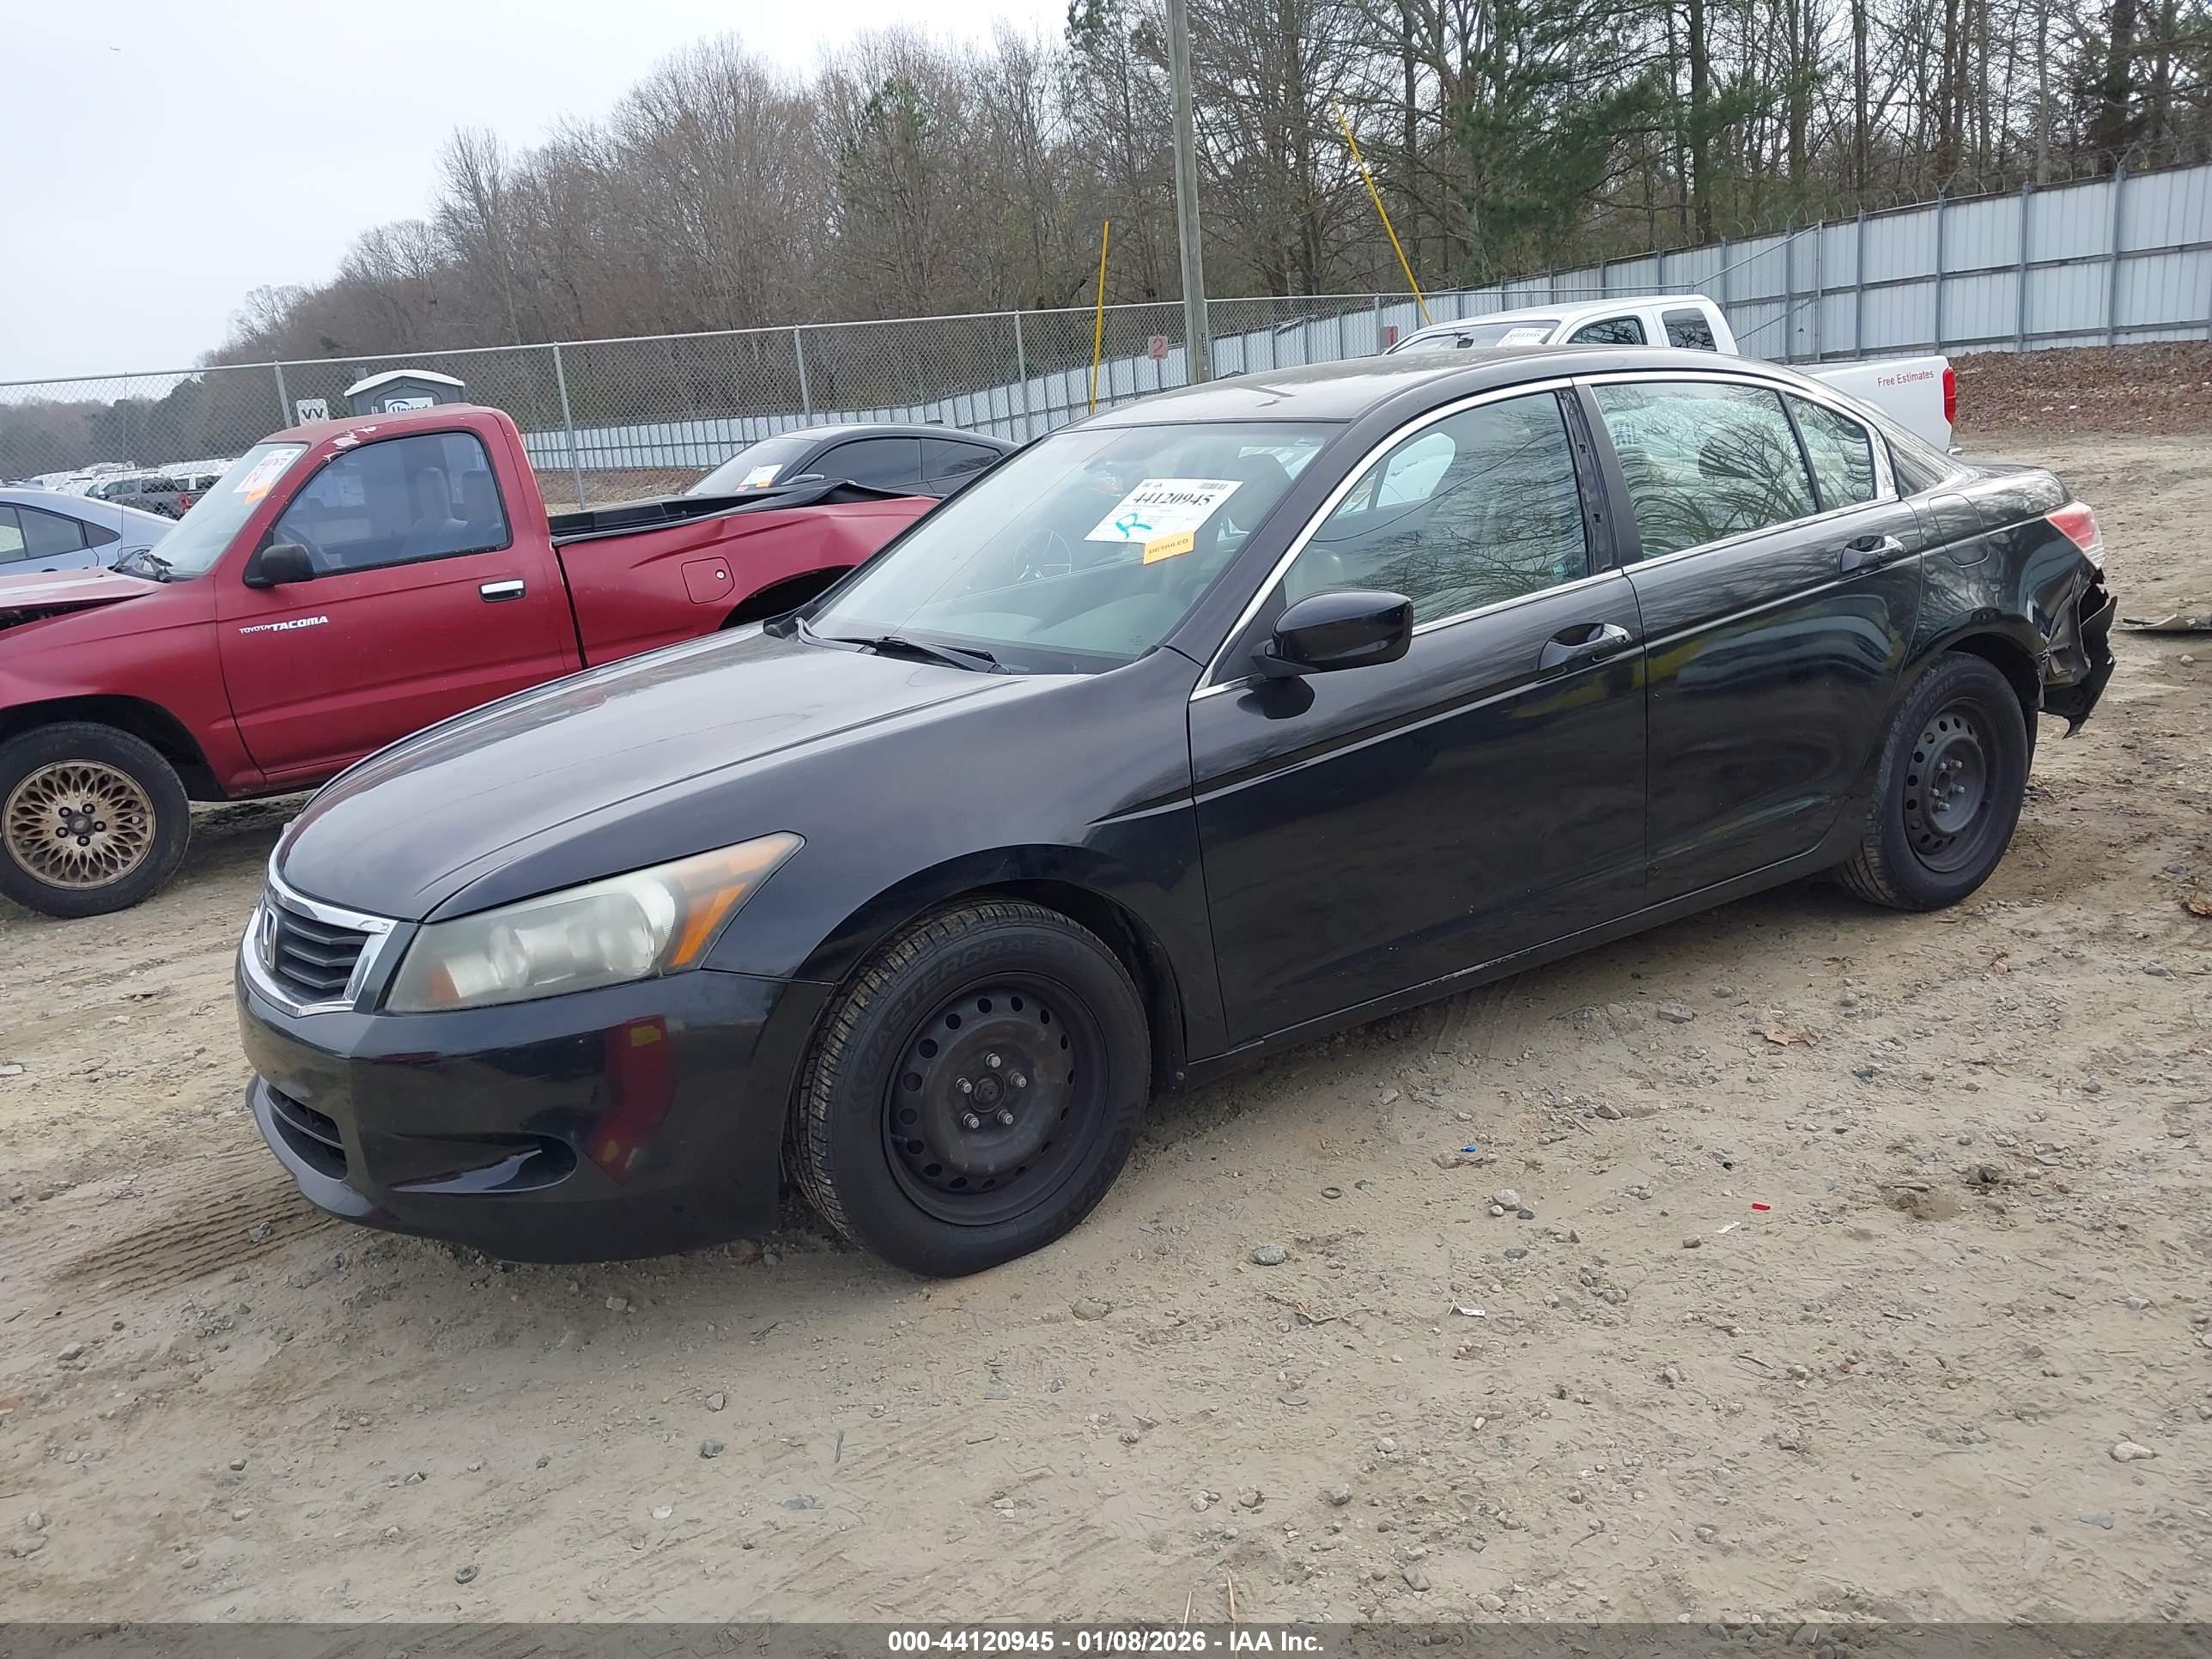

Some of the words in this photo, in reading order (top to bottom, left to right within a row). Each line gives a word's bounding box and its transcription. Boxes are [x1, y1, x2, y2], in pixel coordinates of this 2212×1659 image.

[1877, 376, 1895, 387] Free
[1896, 370, 1935, 384] Estimates
[1133, 492, 1217, 506] 44120945
[1149, 538, 1189, 554] DETAILED
[239, 624, 271, 634] TOYOTA
[270, 616, 328, 631] TACOMA
